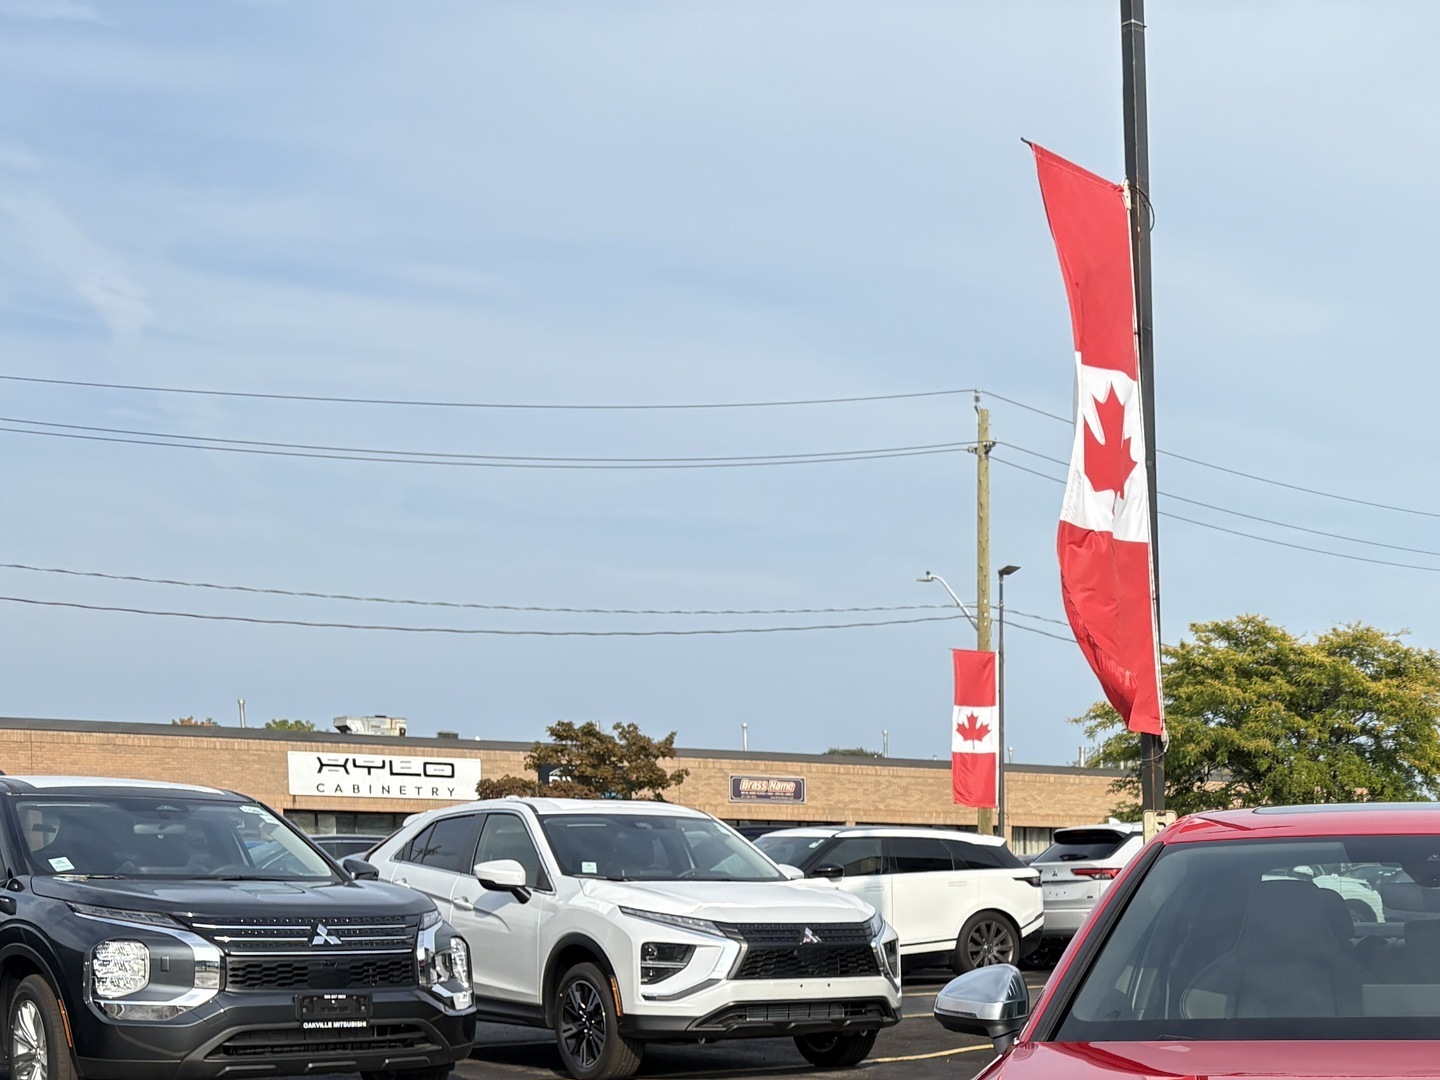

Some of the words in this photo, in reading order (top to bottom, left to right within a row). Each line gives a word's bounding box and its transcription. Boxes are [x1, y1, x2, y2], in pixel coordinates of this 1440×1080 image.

[316, 783, 455, 797] CABINETRY
[303, 1021, 332, 1029] OAKVILLE
[333, 1020, 367, 1028] MITSUBISHI
